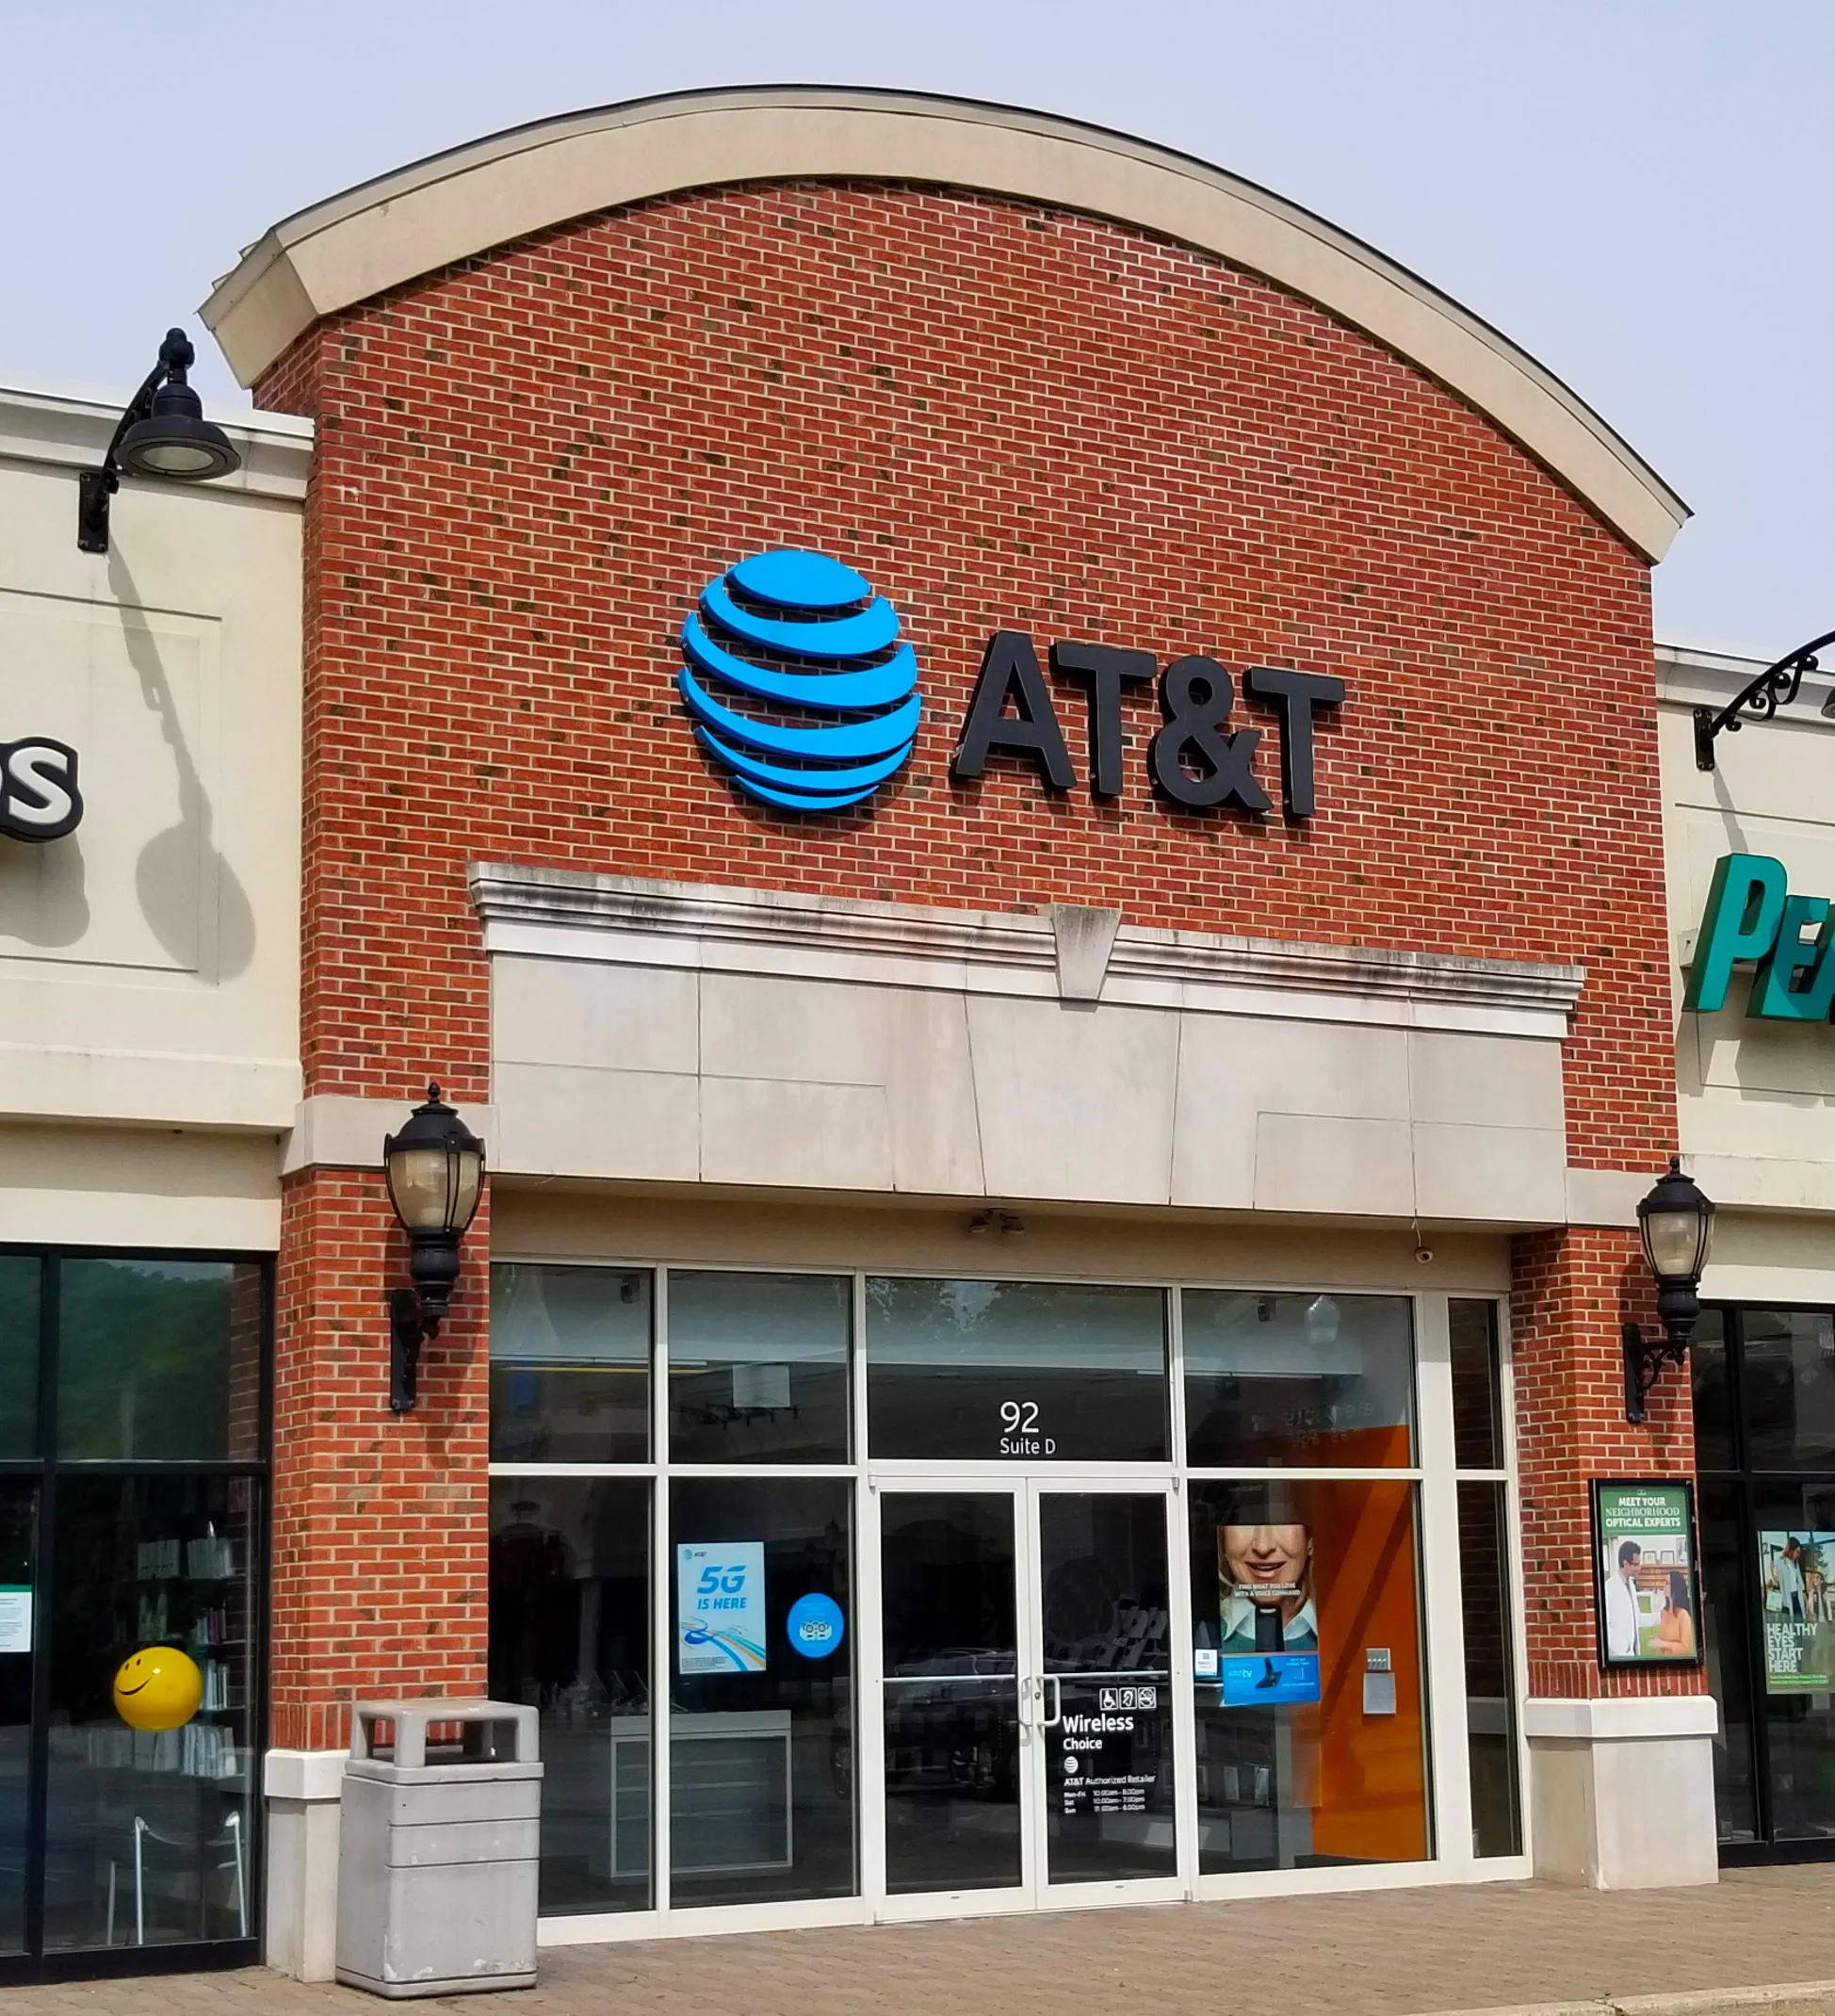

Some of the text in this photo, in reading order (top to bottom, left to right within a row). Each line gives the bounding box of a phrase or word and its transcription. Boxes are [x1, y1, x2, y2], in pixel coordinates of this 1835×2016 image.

[952, 629, 1347, 818] AT&T
[1682, 852, 1835, 1022] PE
[999, 1401, 1040, 1433] 92
[999, 1438, 1056, 1455] Suite D
[1618, 1496, 1666, 1506] MEET YOUR
[1605, 1507, 1680, 1517] NEIGHBORHOOD
[1605, 1518, 1681, 1527] OPTICAL EXPERTS
[696, 1564, 747, 1594] 5G
[697, 1597, 747, 1610] IS HERE
[1766, 1622, 1818, 1635] HEALTHY
[1767, 1634, 1794, 1648] EYES
[1768, 1647, 1804, 1660] START
[1769, 1659, 1797, 1673] HERE
[1063, 1713, 1134, 1733] Wireless
[1063, 1737, 1103, 1750] Choice
[1064, 1774, 1156, 1786] AT&T Authorized Retailer
